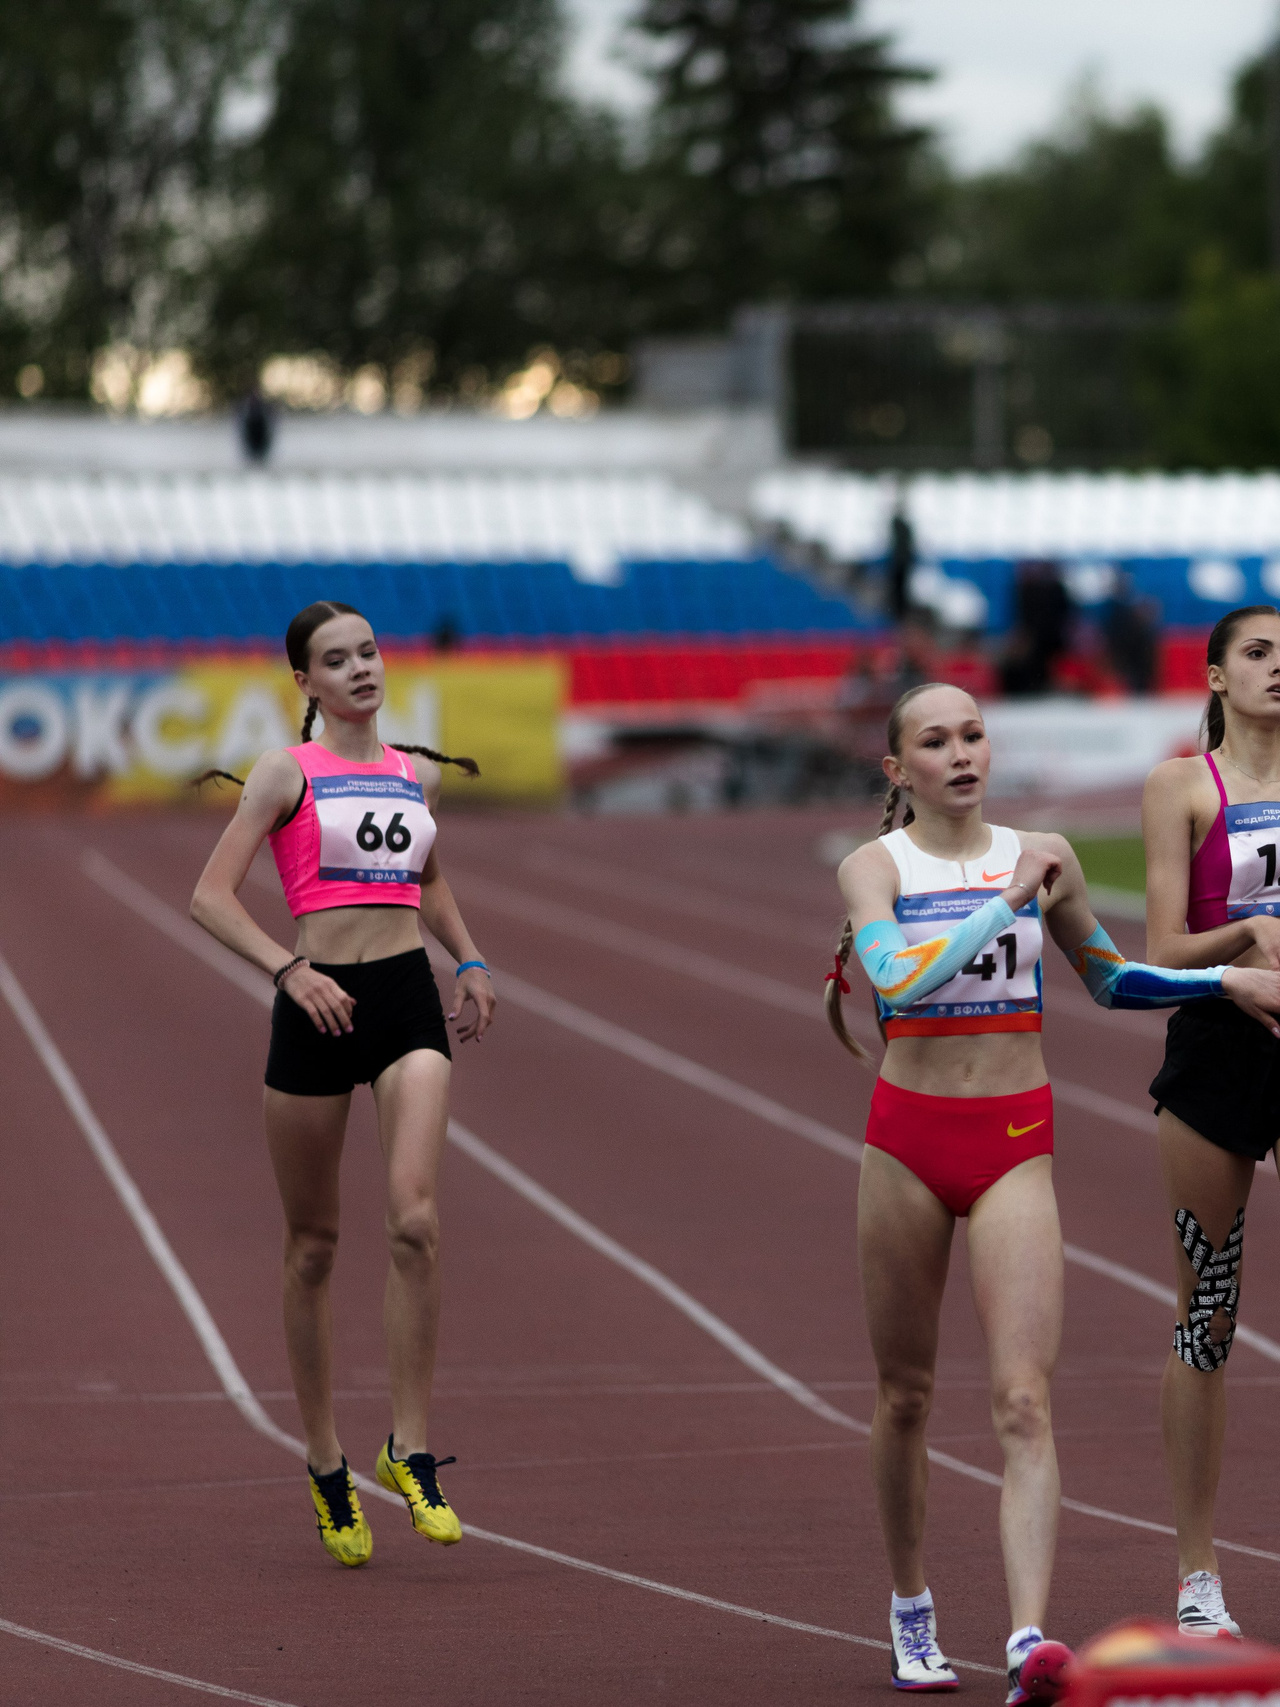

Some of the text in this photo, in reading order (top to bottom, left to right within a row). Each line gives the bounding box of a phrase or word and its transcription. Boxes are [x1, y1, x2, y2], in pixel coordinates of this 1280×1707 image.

[347, 780, 403, 788] ПЕРВЕНСТВО
[321, 786, 395, 794] ФЕДЕРАЛЬНОГО
[356, 811, 412, 853] 66
[933, 898, 991, 908] ПЕРВЕНСТ
[952, 933, 1017, 981] 41
[953, 1004, 991, 1015] ВФЛА
